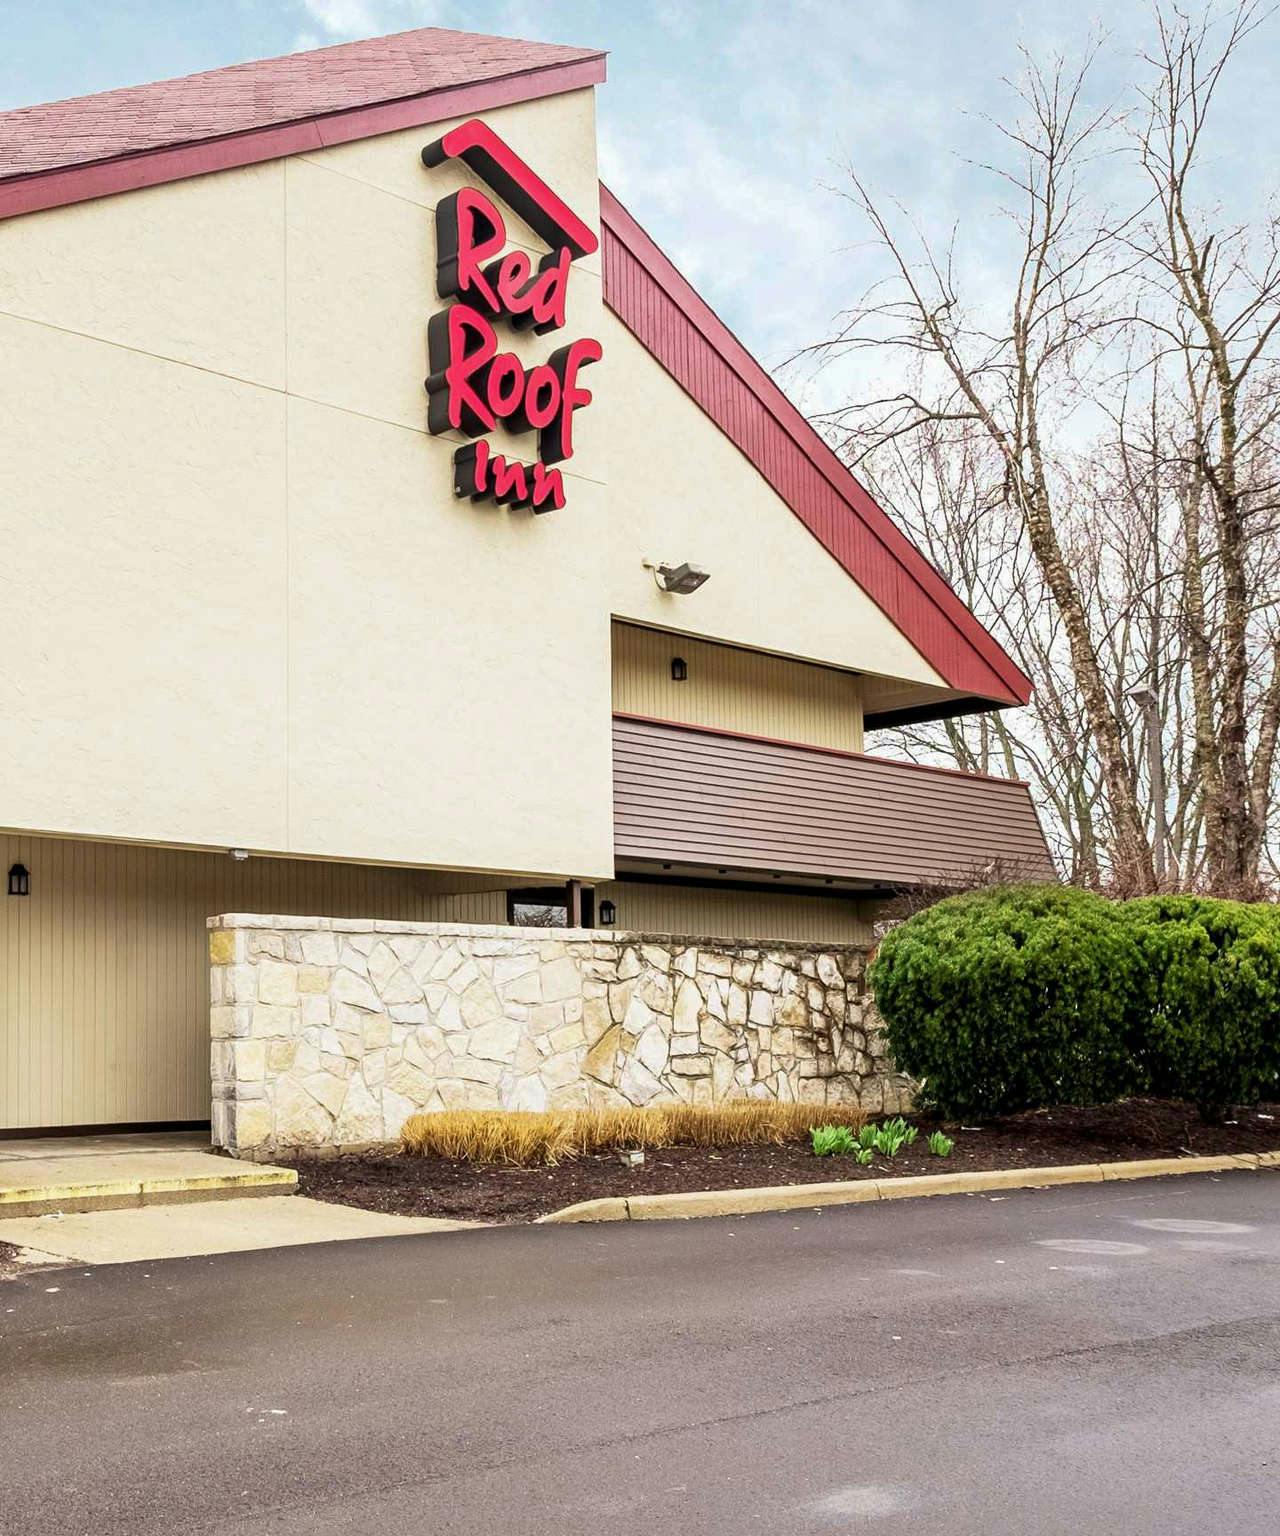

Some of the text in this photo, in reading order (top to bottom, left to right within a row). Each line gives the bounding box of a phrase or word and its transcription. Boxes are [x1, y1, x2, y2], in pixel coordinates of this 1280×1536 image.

[456, 187, 572, 328] Red
[446, 304, 603, 459] Roof
[475, 439, 566, 509] Inn
